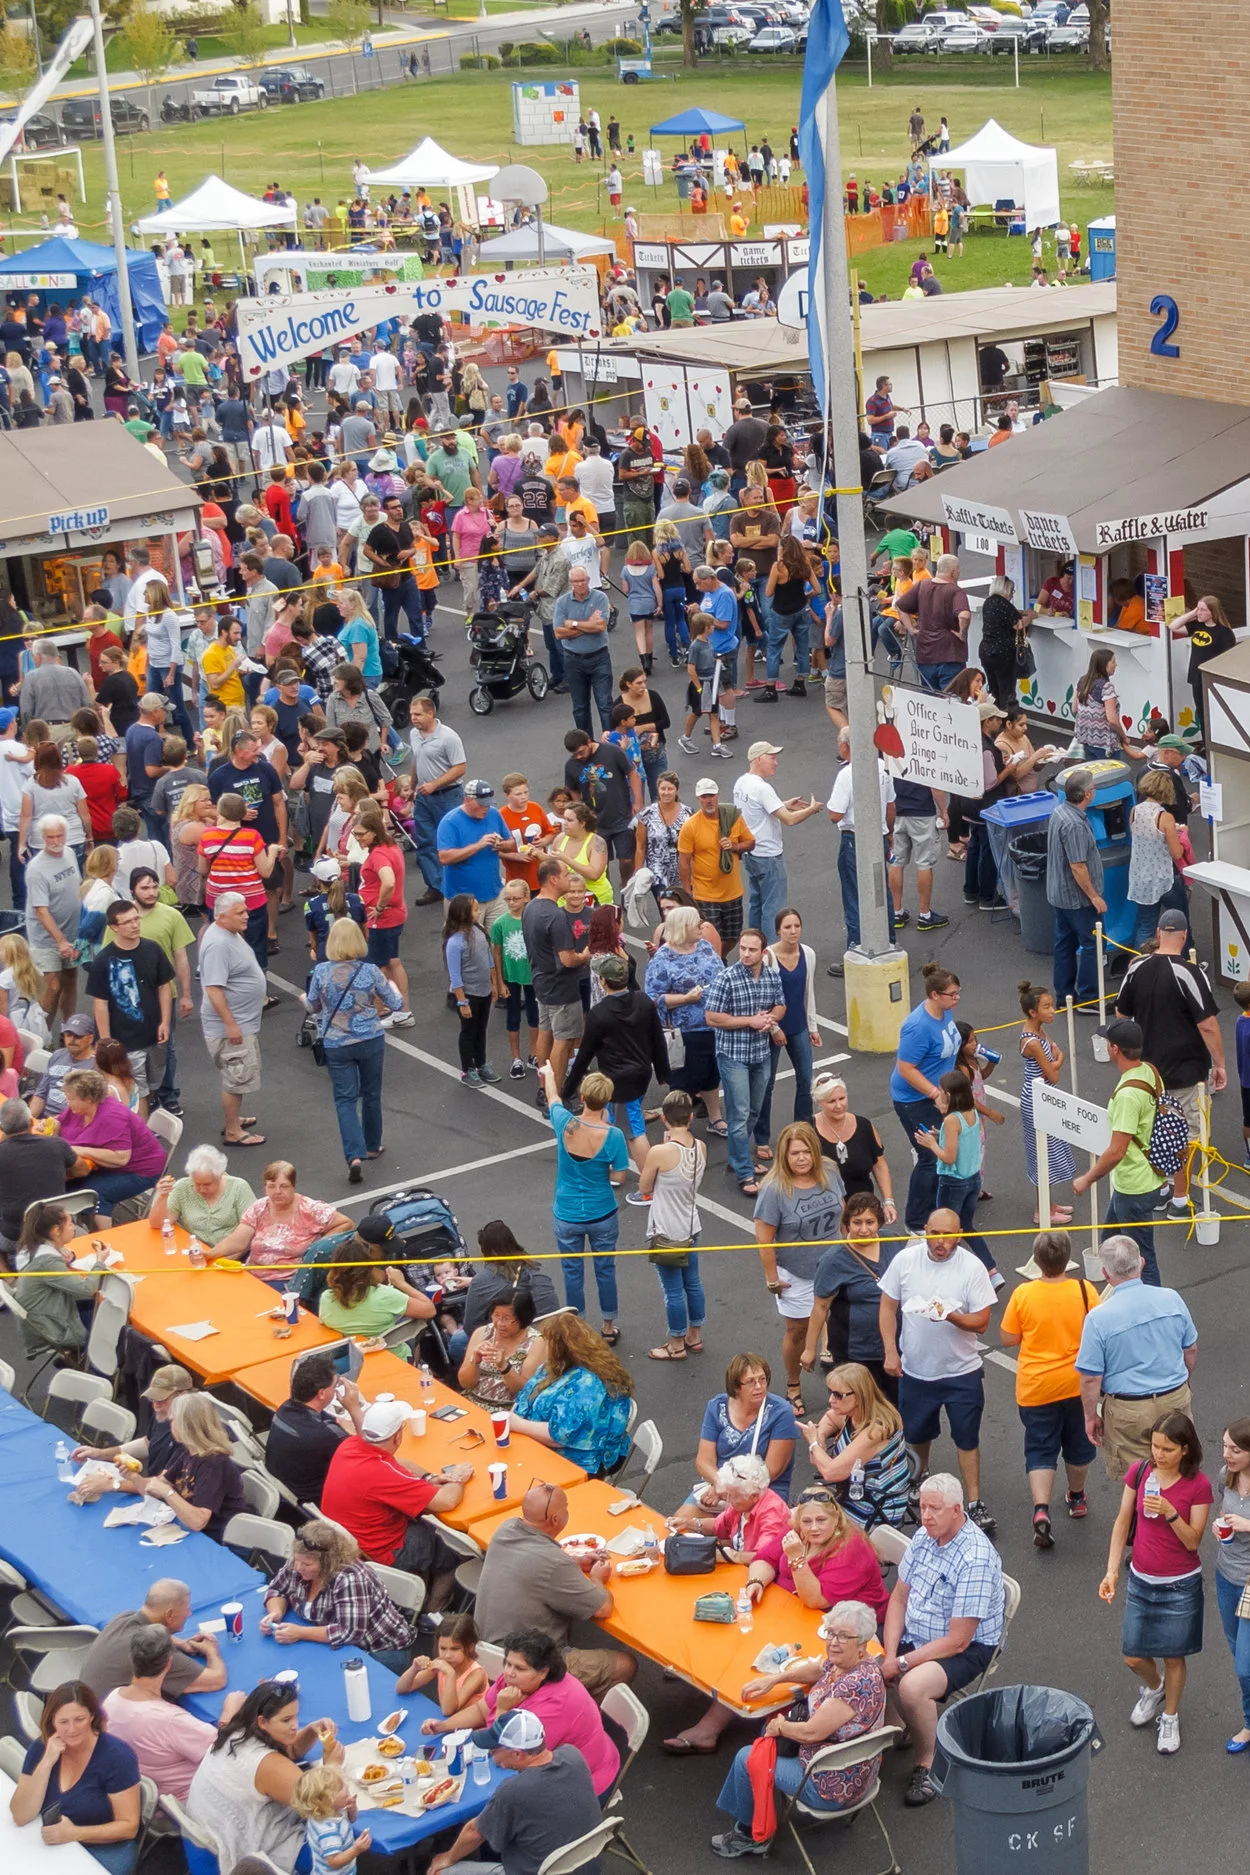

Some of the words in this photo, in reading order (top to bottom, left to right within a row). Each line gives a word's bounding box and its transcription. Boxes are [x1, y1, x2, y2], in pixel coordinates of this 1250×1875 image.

[384, 257, 400, 267] Golf
[638, 251, 665, 263] Tickets
[740, 255, 769, 265] tickets
[742, 246, 766, 256] game
[247, 302, 361, 363] Welcome
[412, 286, 442, 309] to
[469, 279, 548, 321] Sausage
[549, 291, 592, 331] Fest
[1149, 294, 1180, 358] 2
[522, 491, 548, 509] 22
[50, 512, 84, 533] Pick
[86, 507, 109, 525] up
[945, 502, 977, 527] Raffle
[977, 513, 1015, 536] Tickets
[1024, 512, 1061, 533] dance
[1098, 517, 1148, 545] Raffle
[1150, 517, 1163, 536] &
[1164, 509, 1208, 533] Water
[1028, 530, 1070, 552] tickets
[907, 700, 938, 722] Office
[910, 719, 930, 740] Bier
[932, 725, 969, 750] Garten
[911, 741, 936, 762] Bingo
[908, 758, 936, 778] More
[940, 767, 968, 787] inside
[1041, 1092, 1067, 1110] ORDER
[1077, 1107, 1099, 1124] FOOD
[1061, 1118, 1081, 1134] HERE
[800, 1195, 834, 1213] EAGLES
[809, 1211, 836, 1236] 72
[1021, 1770, 1066, 1789] BRUTE
[1008, 1831, 1039, 1850] CK
[1053, 1816, 1076, 1843] SF
